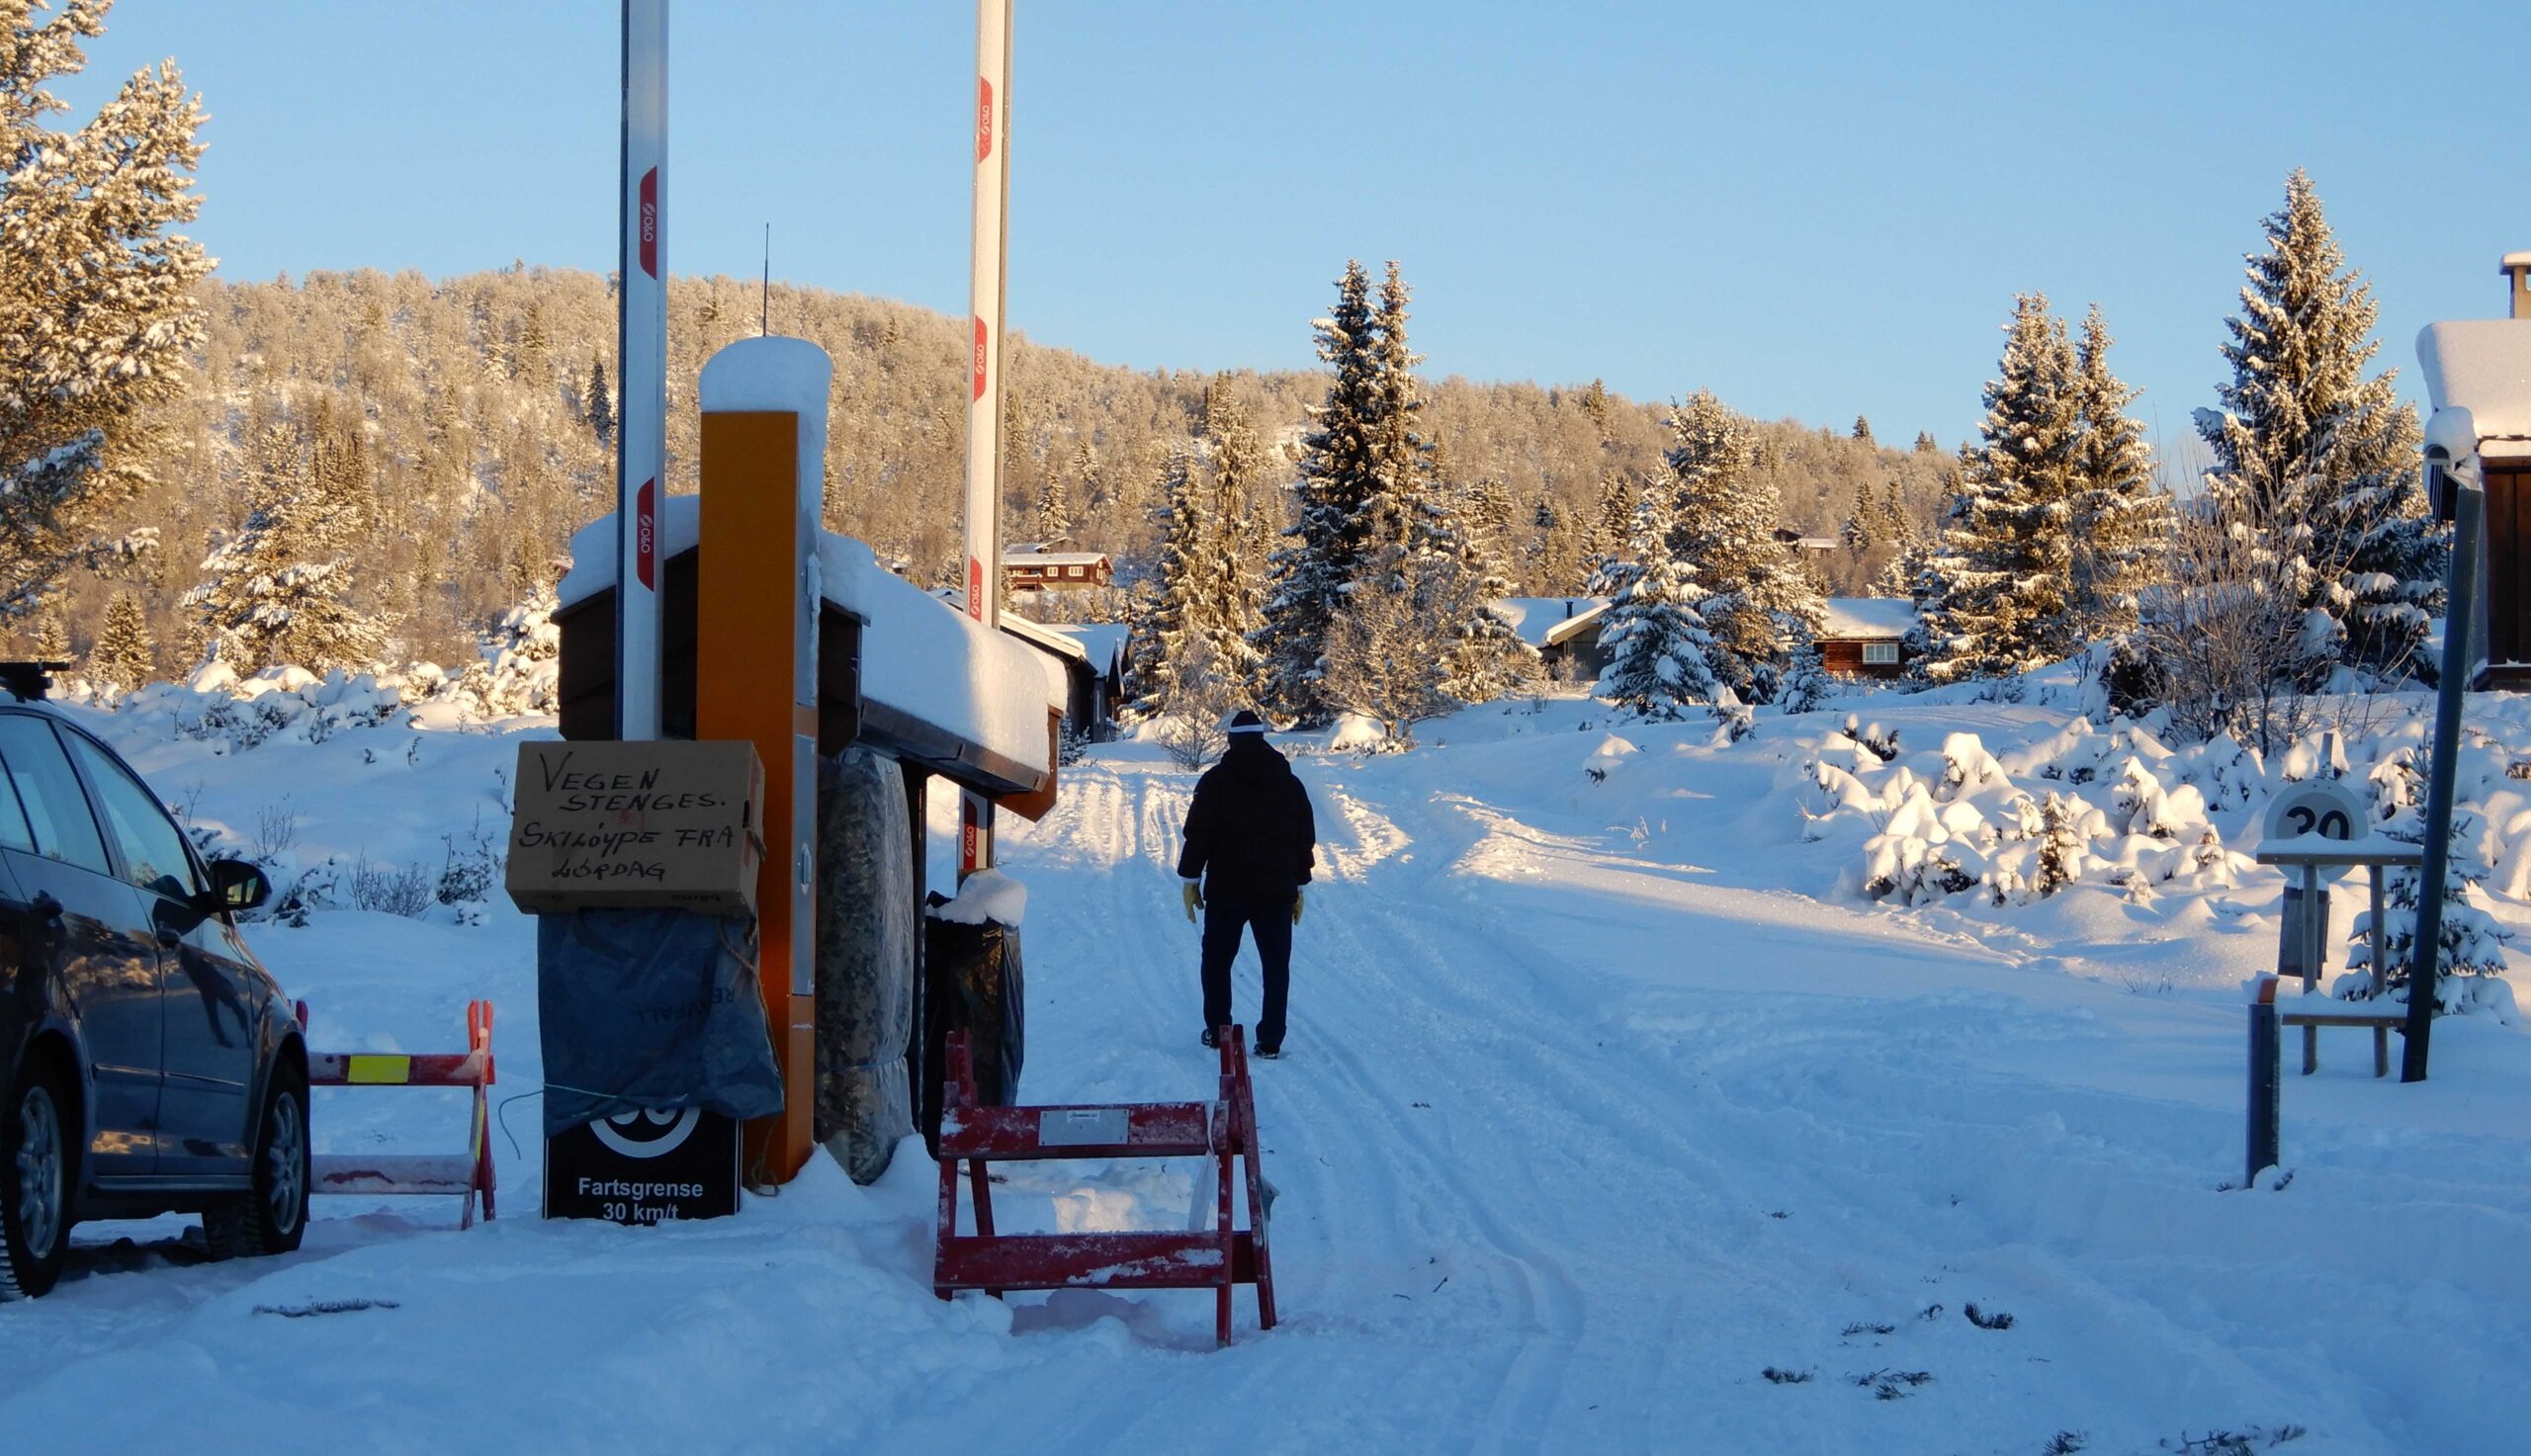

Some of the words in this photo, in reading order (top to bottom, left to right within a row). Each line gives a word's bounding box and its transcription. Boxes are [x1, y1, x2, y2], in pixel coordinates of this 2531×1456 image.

[539, 751, 660, 792] VEGEN
[559, 793, 726, 812] STENGES.
[2286, 806, 2350, 840] 30
[674, 825, 735, 848] FRA
[578, 1177, 704, 1201] Fartsgrense
[602, 1203, 627, 1220] 30
[634, 1202, 679, 1222] km/t
